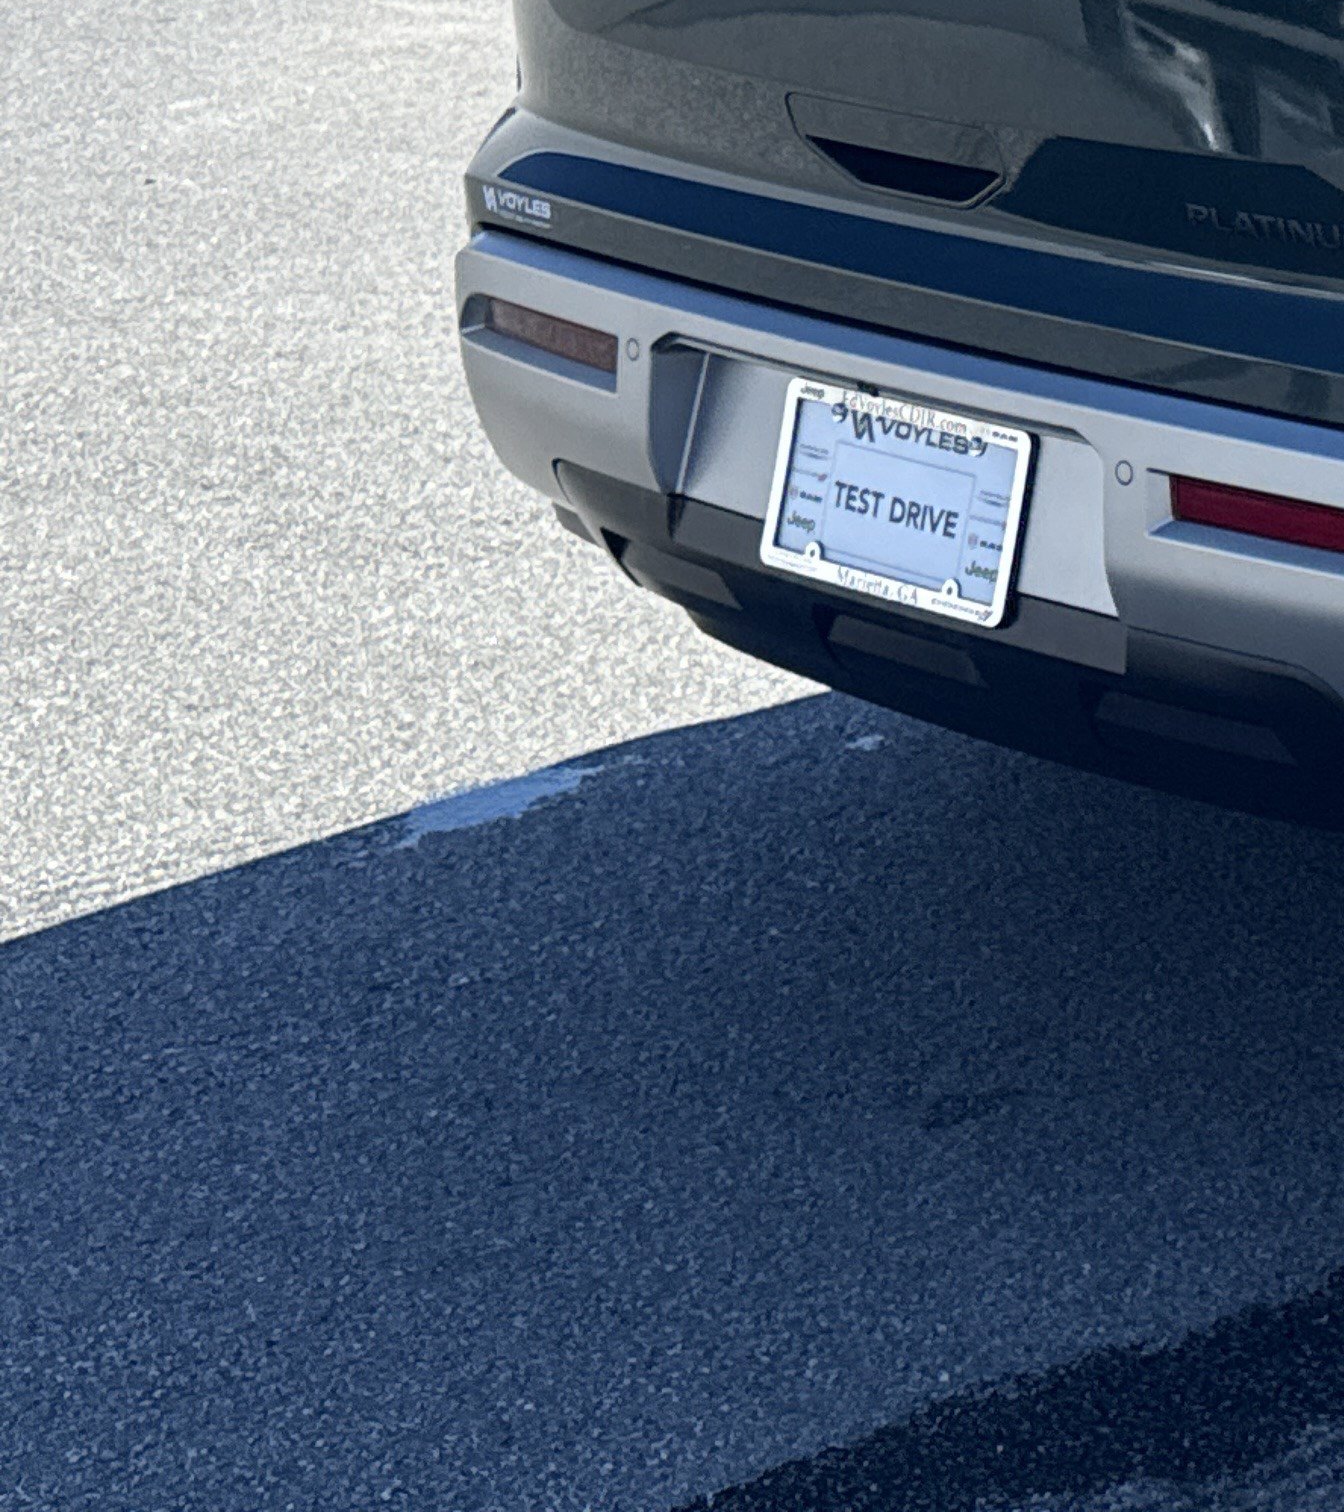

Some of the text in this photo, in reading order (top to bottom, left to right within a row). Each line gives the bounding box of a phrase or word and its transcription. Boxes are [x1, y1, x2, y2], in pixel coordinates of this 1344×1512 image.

[497, 189, 552, 220] VOYLES
[875, 415, 969, 456] VOYLES
[834, 480, 885, 519] TEST
[888, 496, 960, 539] DRIVE
